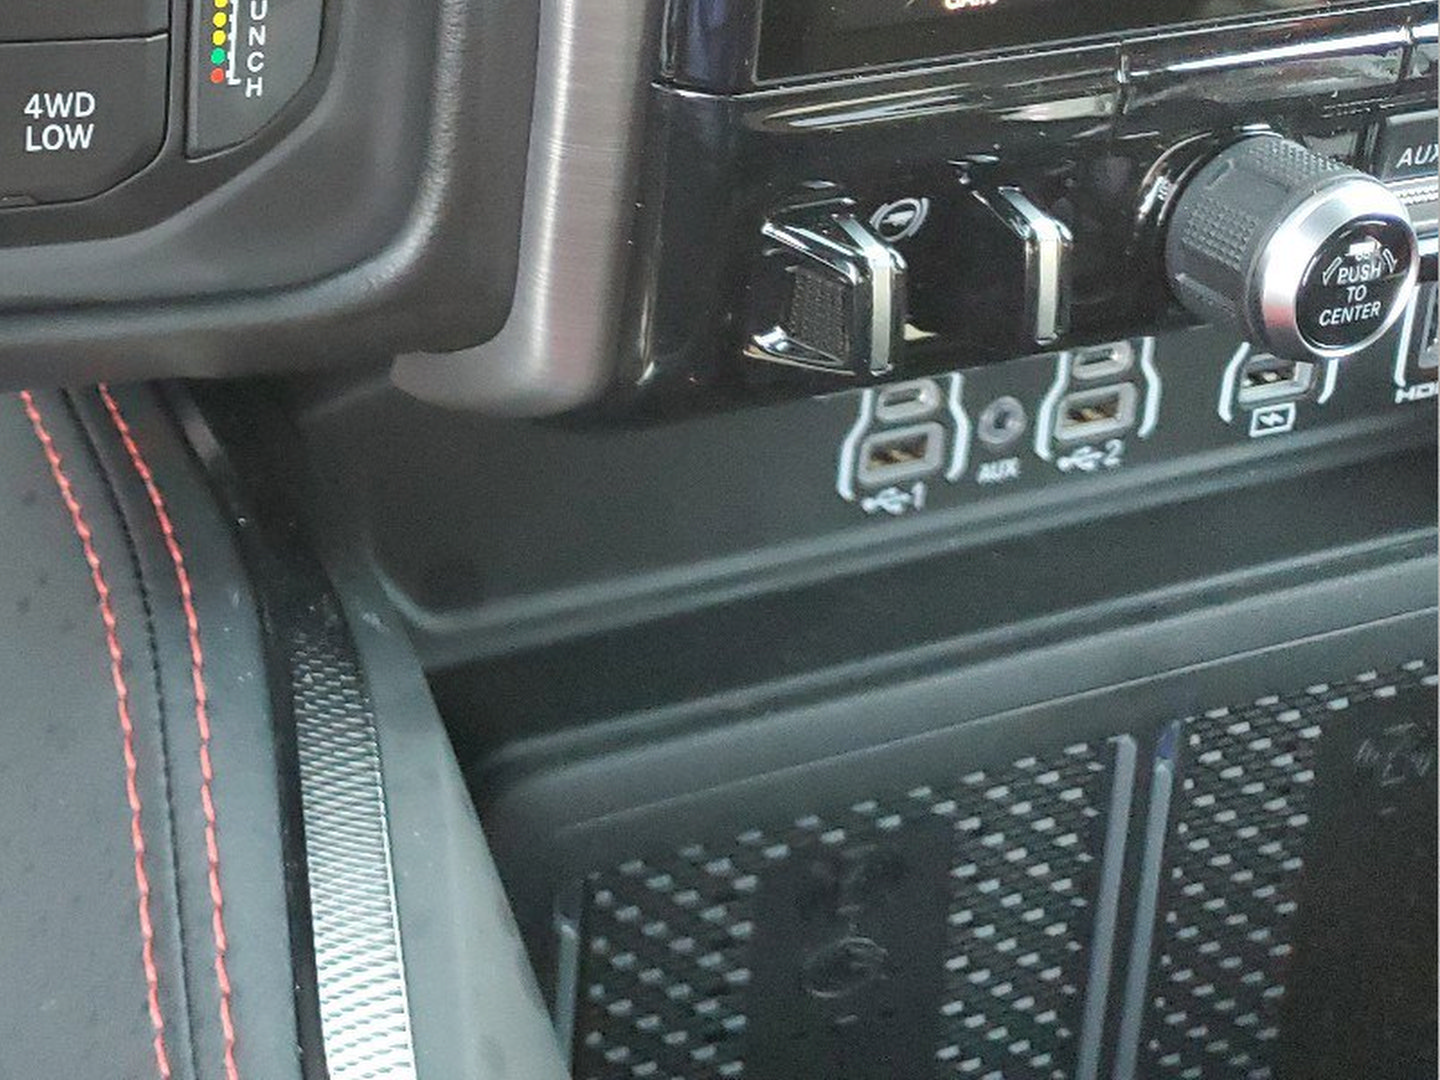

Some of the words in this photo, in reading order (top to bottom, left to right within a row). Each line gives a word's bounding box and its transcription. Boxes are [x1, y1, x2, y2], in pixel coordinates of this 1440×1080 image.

[24, 91, 96, 119] 4WD
[25, 123, 94, 151] LOW
[1337, 262, 1382, 286] PUSH
[1346, 284, 1367, 304] TO
[1319, 301, 1382, 326] CENTER
[1395, 381, 1438, 404] HD
[1104, 439, 1123, 467] 2
[976, 456, 1020, 485] AUX
